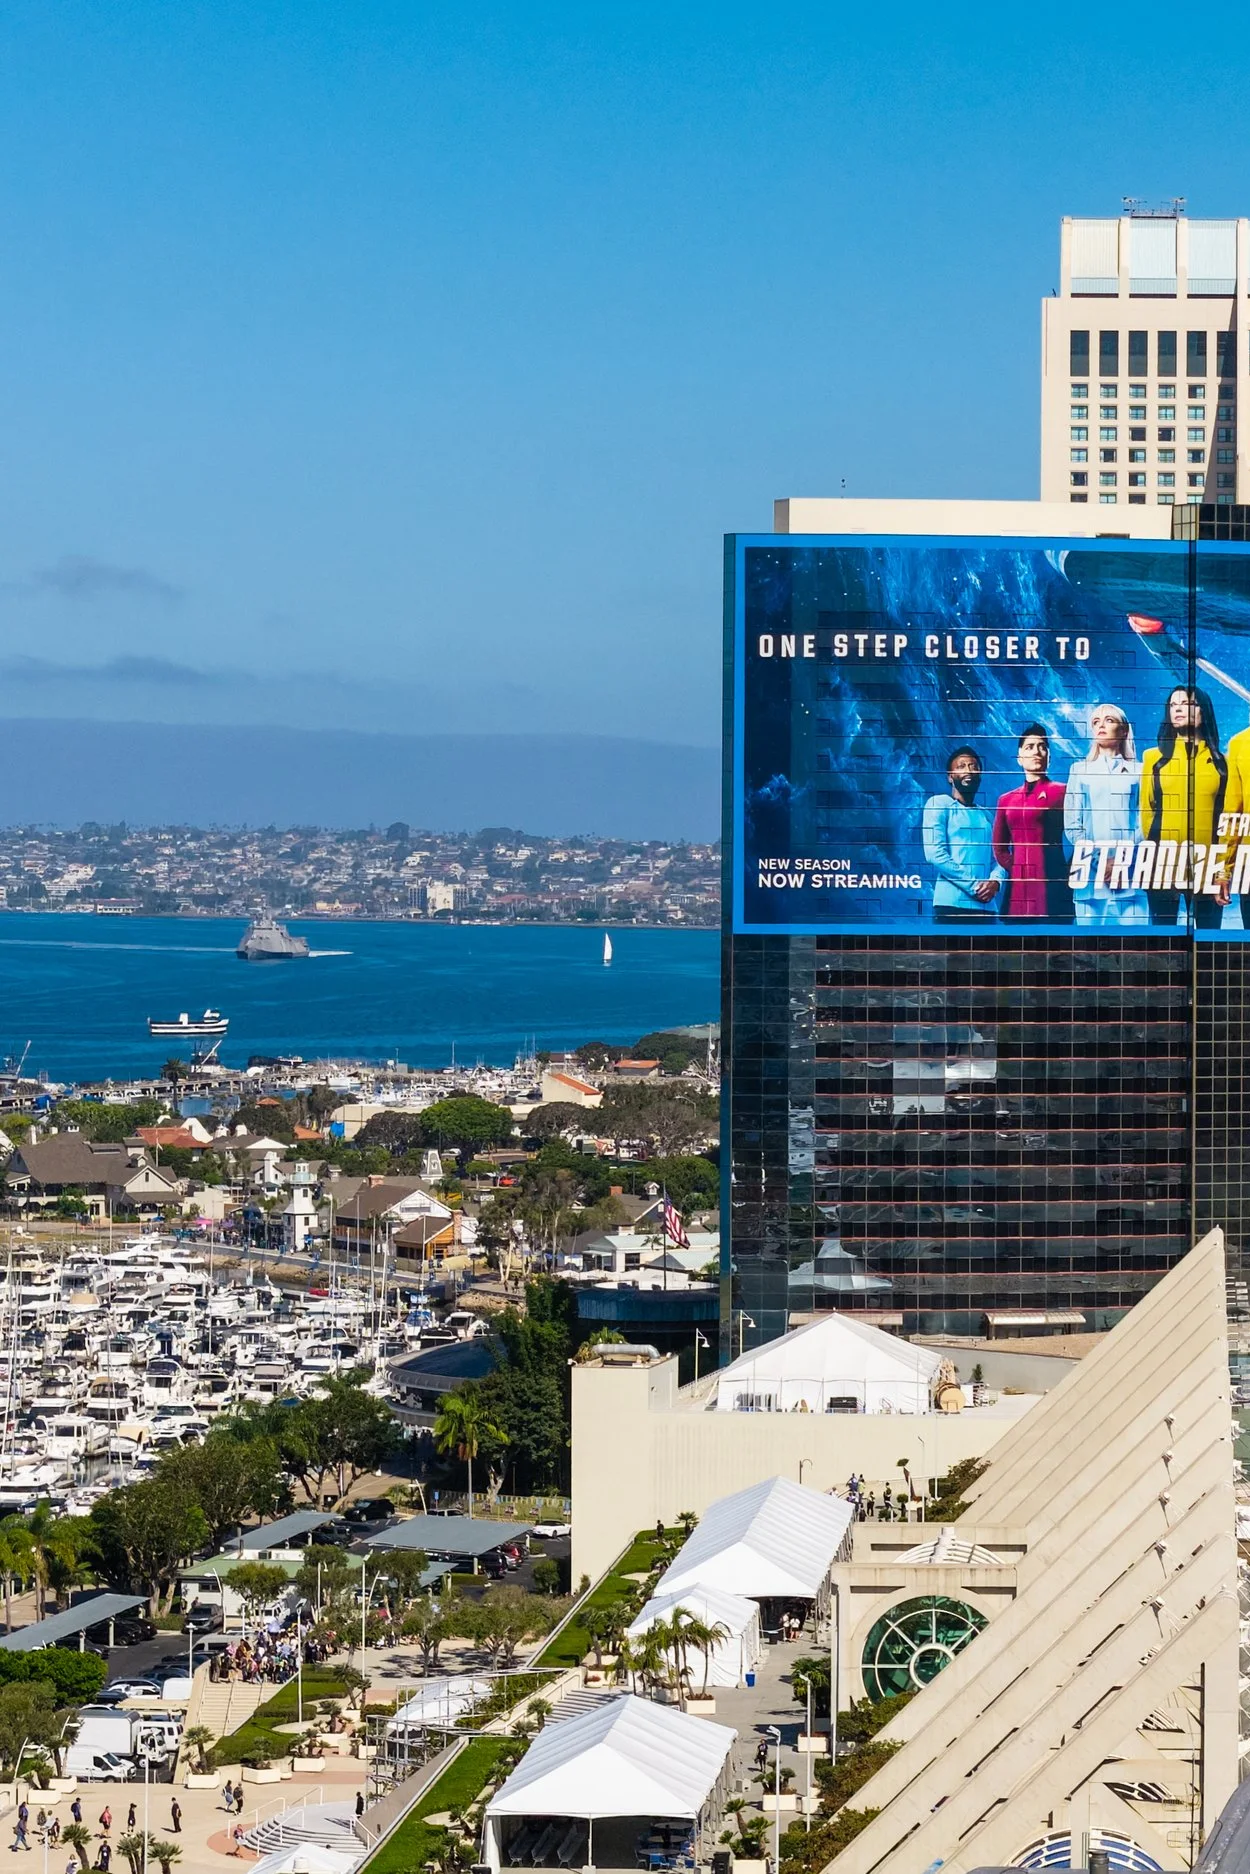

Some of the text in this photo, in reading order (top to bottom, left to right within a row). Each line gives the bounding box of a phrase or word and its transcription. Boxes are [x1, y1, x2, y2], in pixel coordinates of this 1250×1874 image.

[759, 634, 1090, 660] ONE STEP CLOSER TO
[758, 858, 851, 871] NEW SEASON
[1068, 839, 1228, 895] STRANGE
[758, 873, 922, 889] NOW STREAMING
